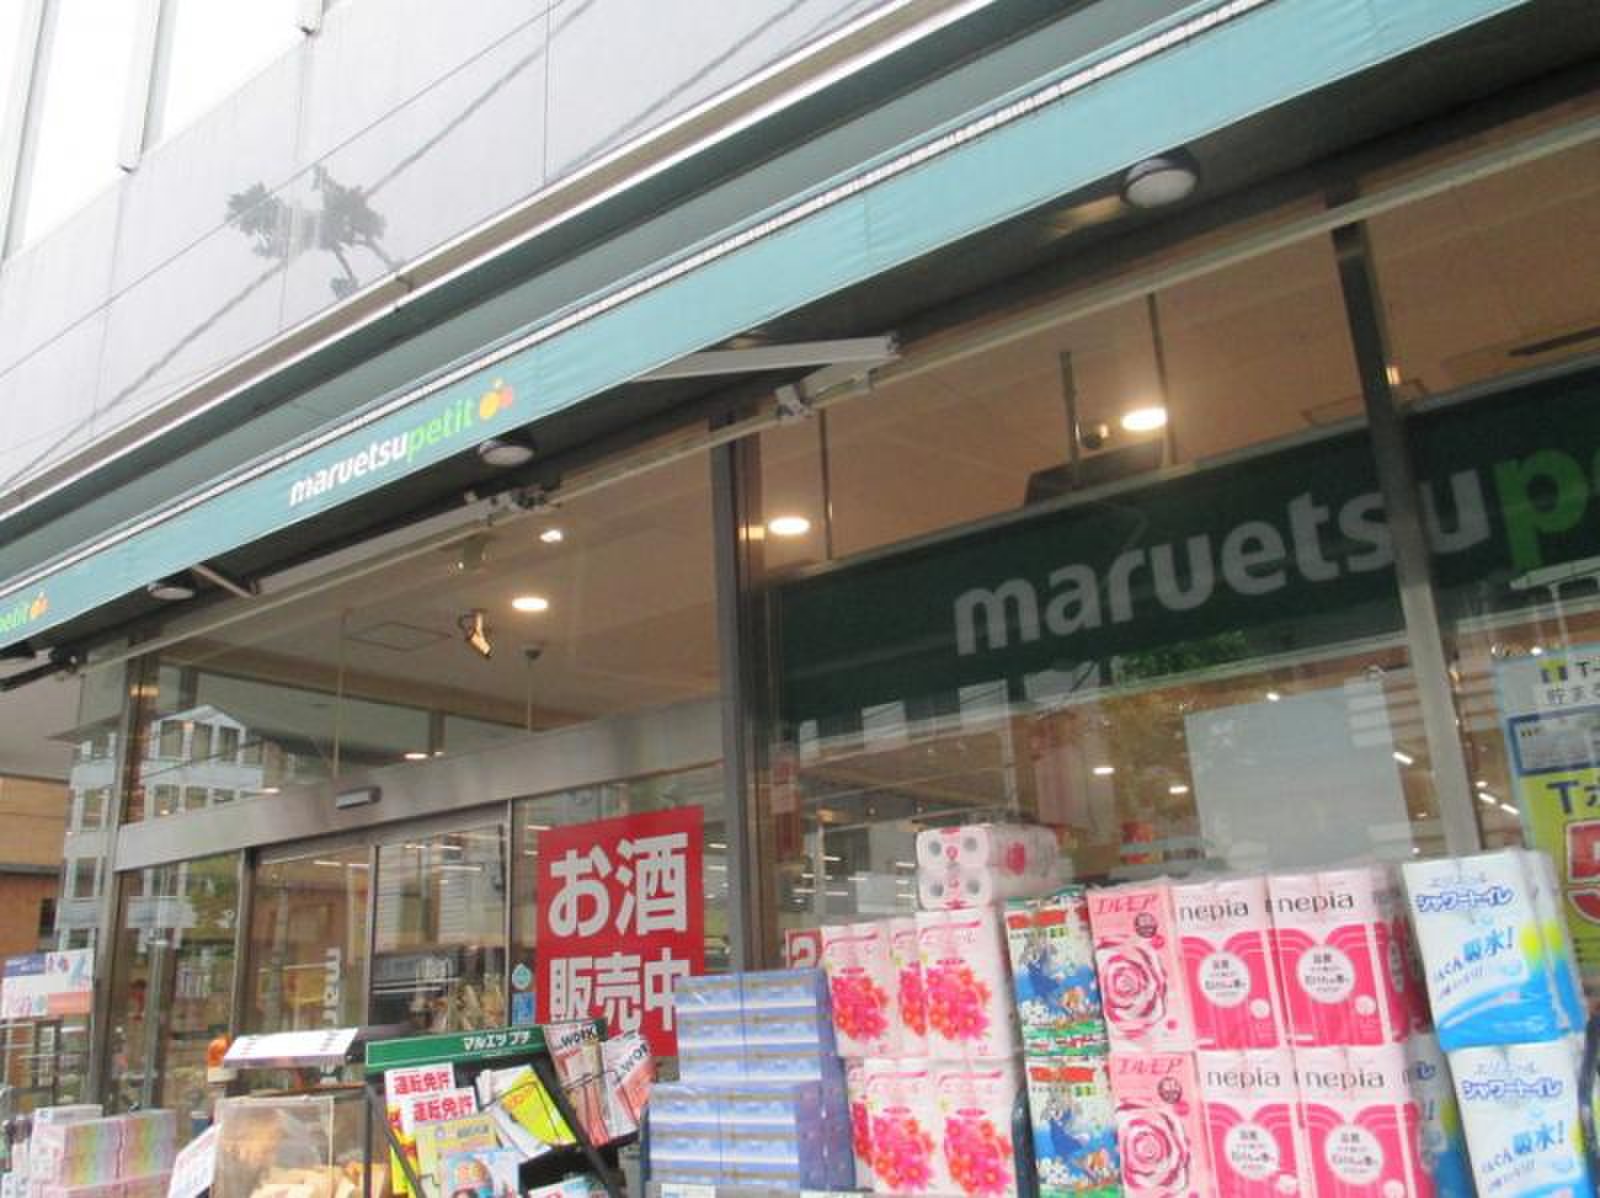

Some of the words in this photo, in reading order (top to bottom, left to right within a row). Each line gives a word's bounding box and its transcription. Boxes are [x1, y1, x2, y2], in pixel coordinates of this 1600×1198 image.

[953, 447, 1600, 657] maruetsup
[547, 832, 689, 938] お酒
[1180, 898, 1249, 922] nepia
[1278, 890, 1354, 914] nepia
[549, 947, 690, 1037] 販売中
[1206, 1066, 1280, 1090] nepia
[1305, 1066, 1385, 1090] nepia
[413, 1095, 474, 1121] 運転免許
